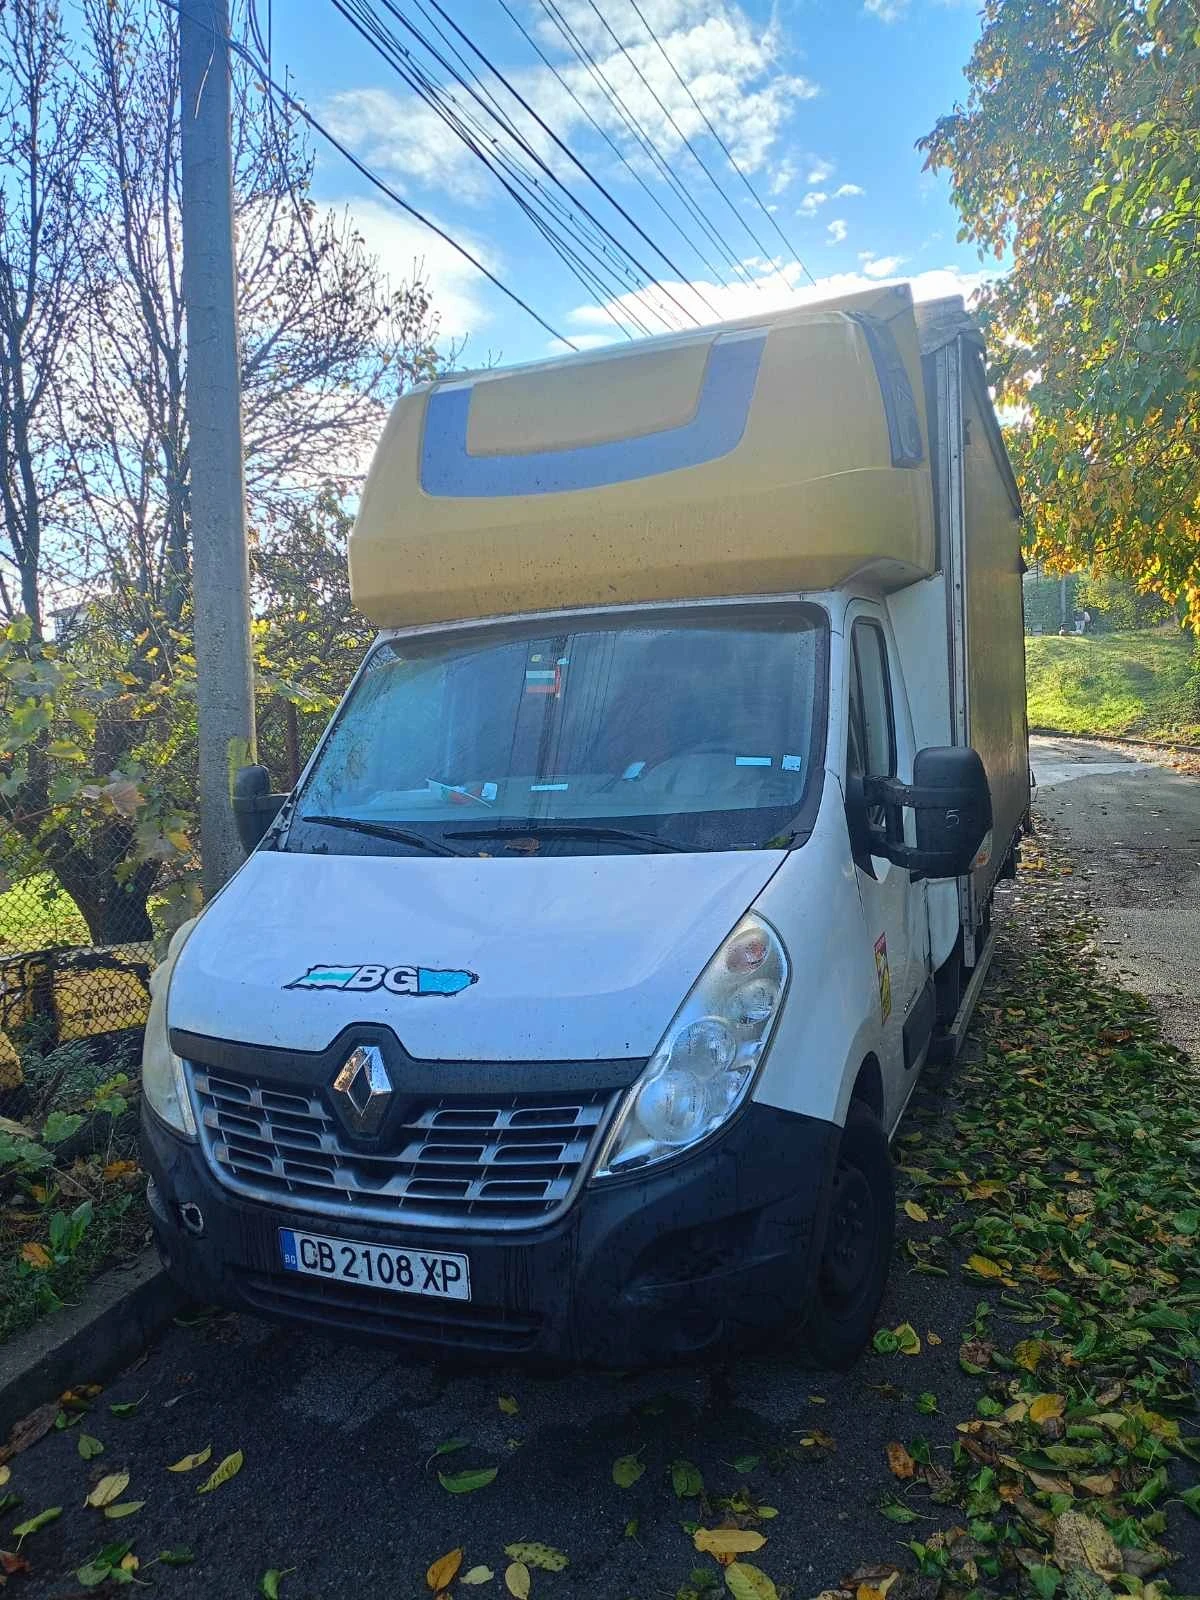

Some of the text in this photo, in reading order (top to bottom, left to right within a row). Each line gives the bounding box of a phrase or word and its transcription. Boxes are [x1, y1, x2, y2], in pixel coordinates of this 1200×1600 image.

[344, 965, 419, 994] BG
[300, 1238, 461, 1292] CB 2108 XP
